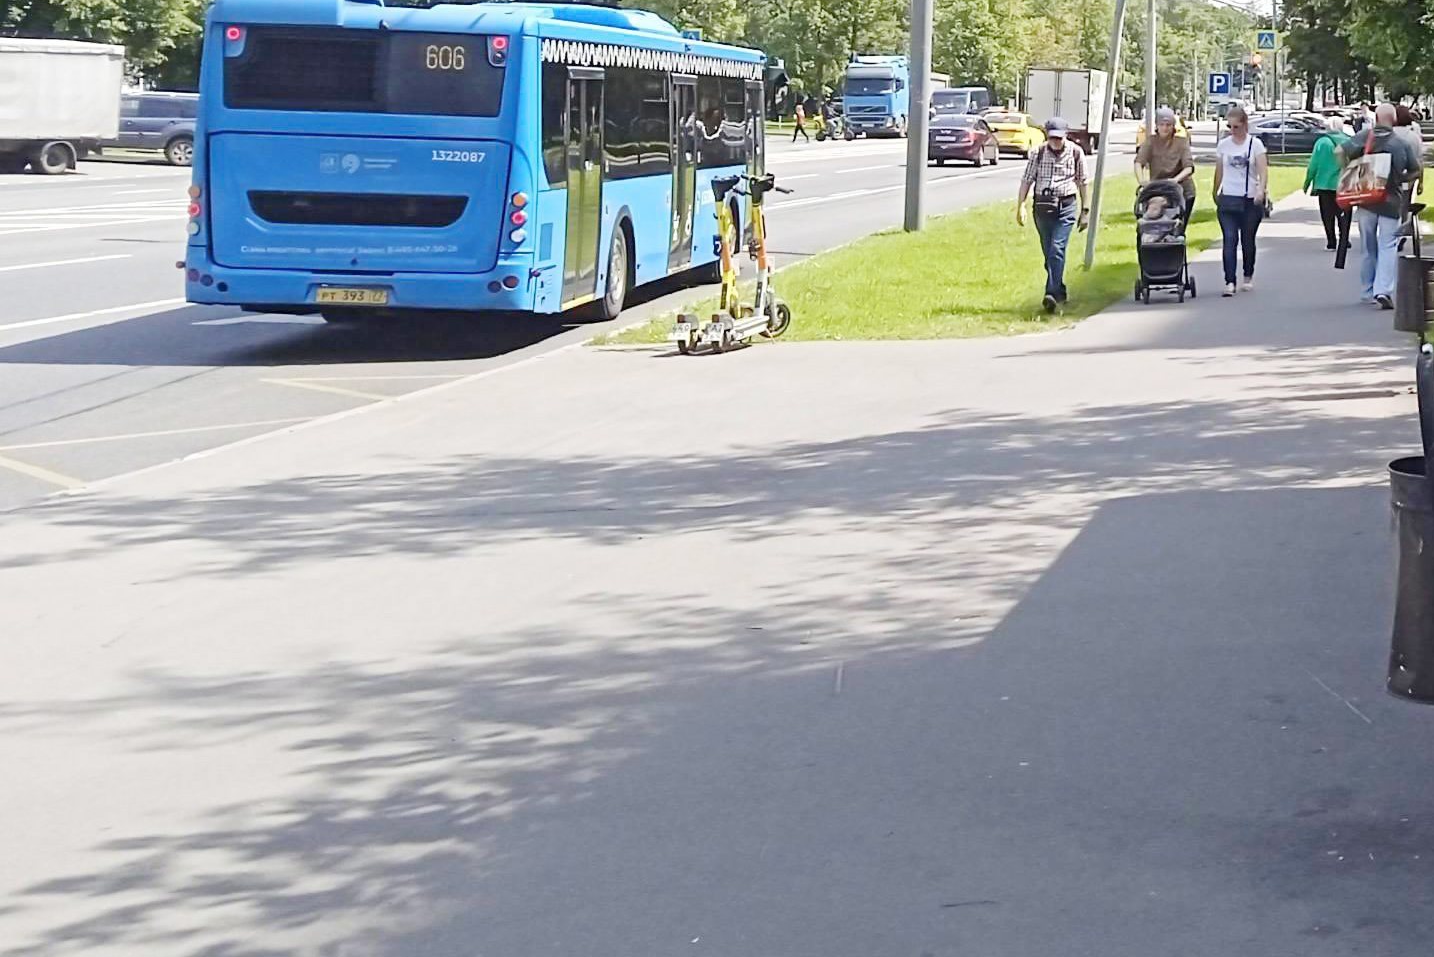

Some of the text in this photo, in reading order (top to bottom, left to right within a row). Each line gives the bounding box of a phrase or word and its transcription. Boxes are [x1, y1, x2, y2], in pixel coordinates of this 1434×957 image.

[426, 45, 465, 70] 606
[1212, 75, 1226, 92] P
[431, 150, 486, 163] 1322087
[343, 290, 365, 301] 393
